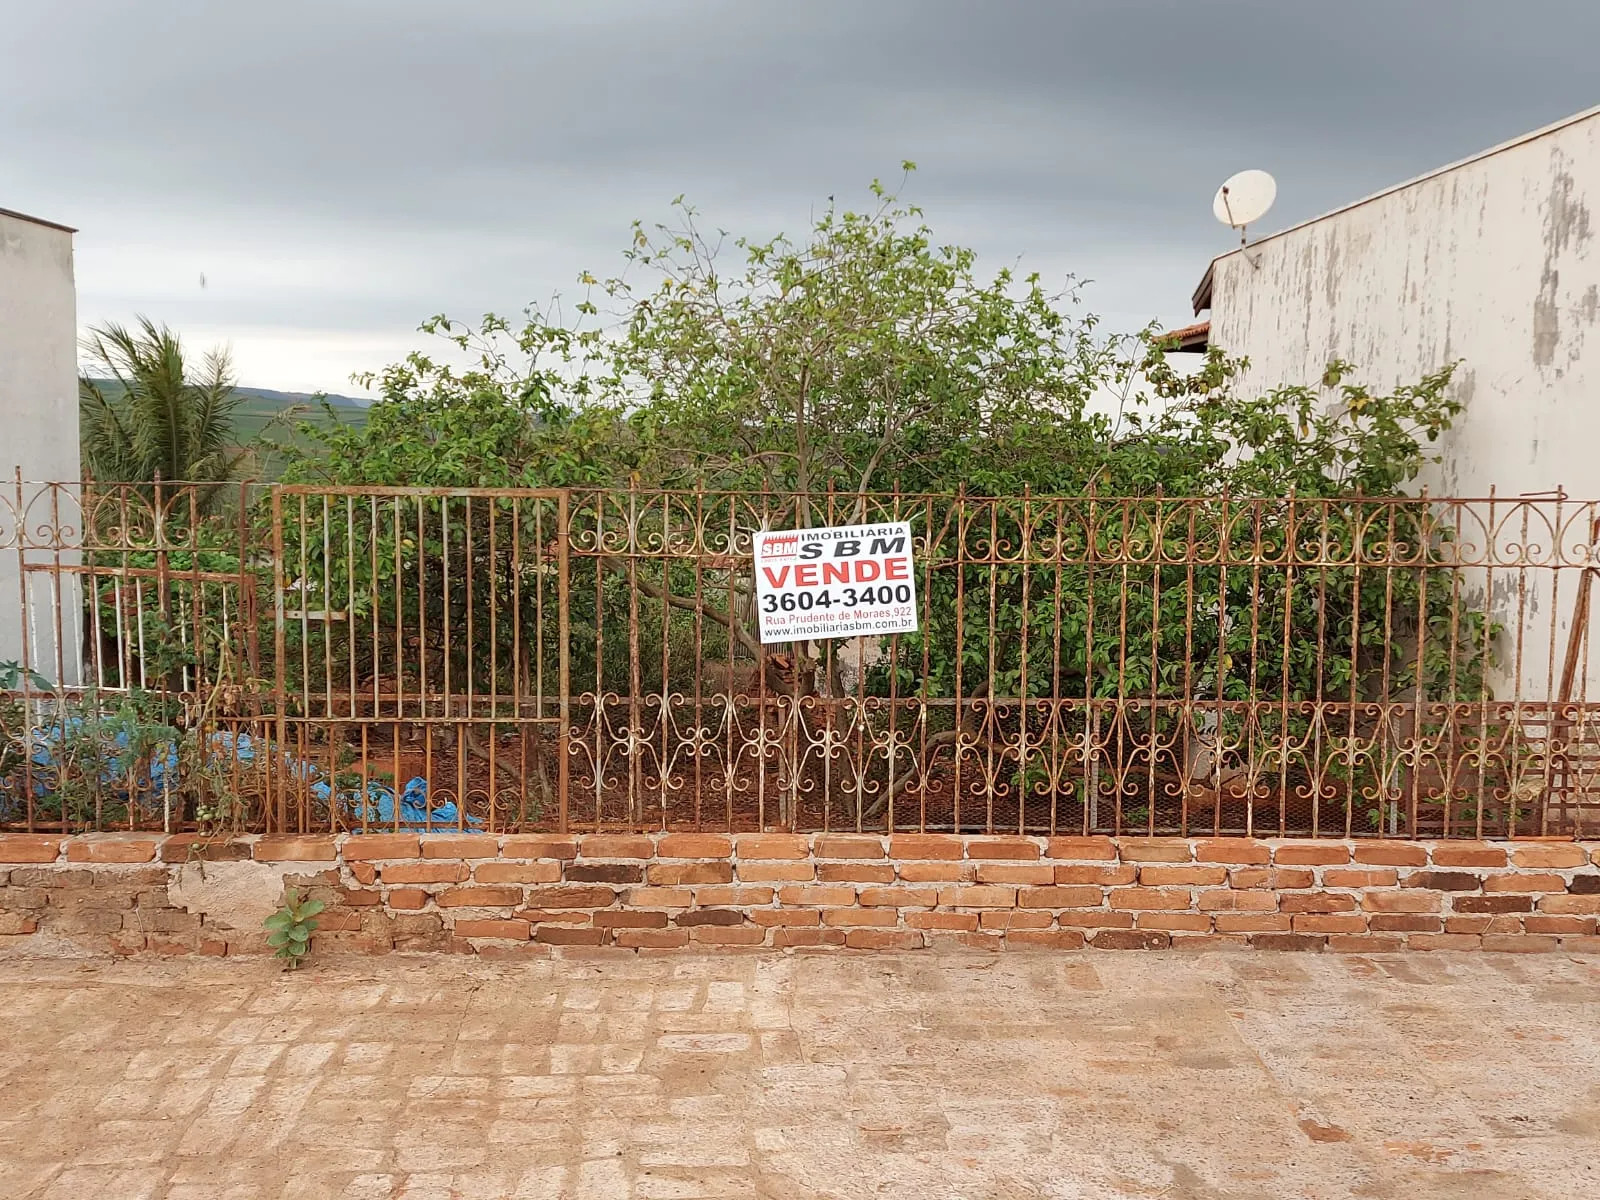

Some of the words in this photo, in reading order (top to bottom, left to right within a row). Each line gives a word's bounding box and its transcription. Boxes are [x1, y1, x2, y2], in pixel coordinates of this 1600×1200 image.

[761, 541, 797, 556] SBM
[762, 557, 909, 588] VENDE
[762, 584, 911, 613] 3604-3400
[765, 615, 786, 625] Rua
[789, 612, 835, 624] Prudente
[838, 610, 851, 620] de
[765, 618, 912, 636] www.imobiliariasbm.com.br
